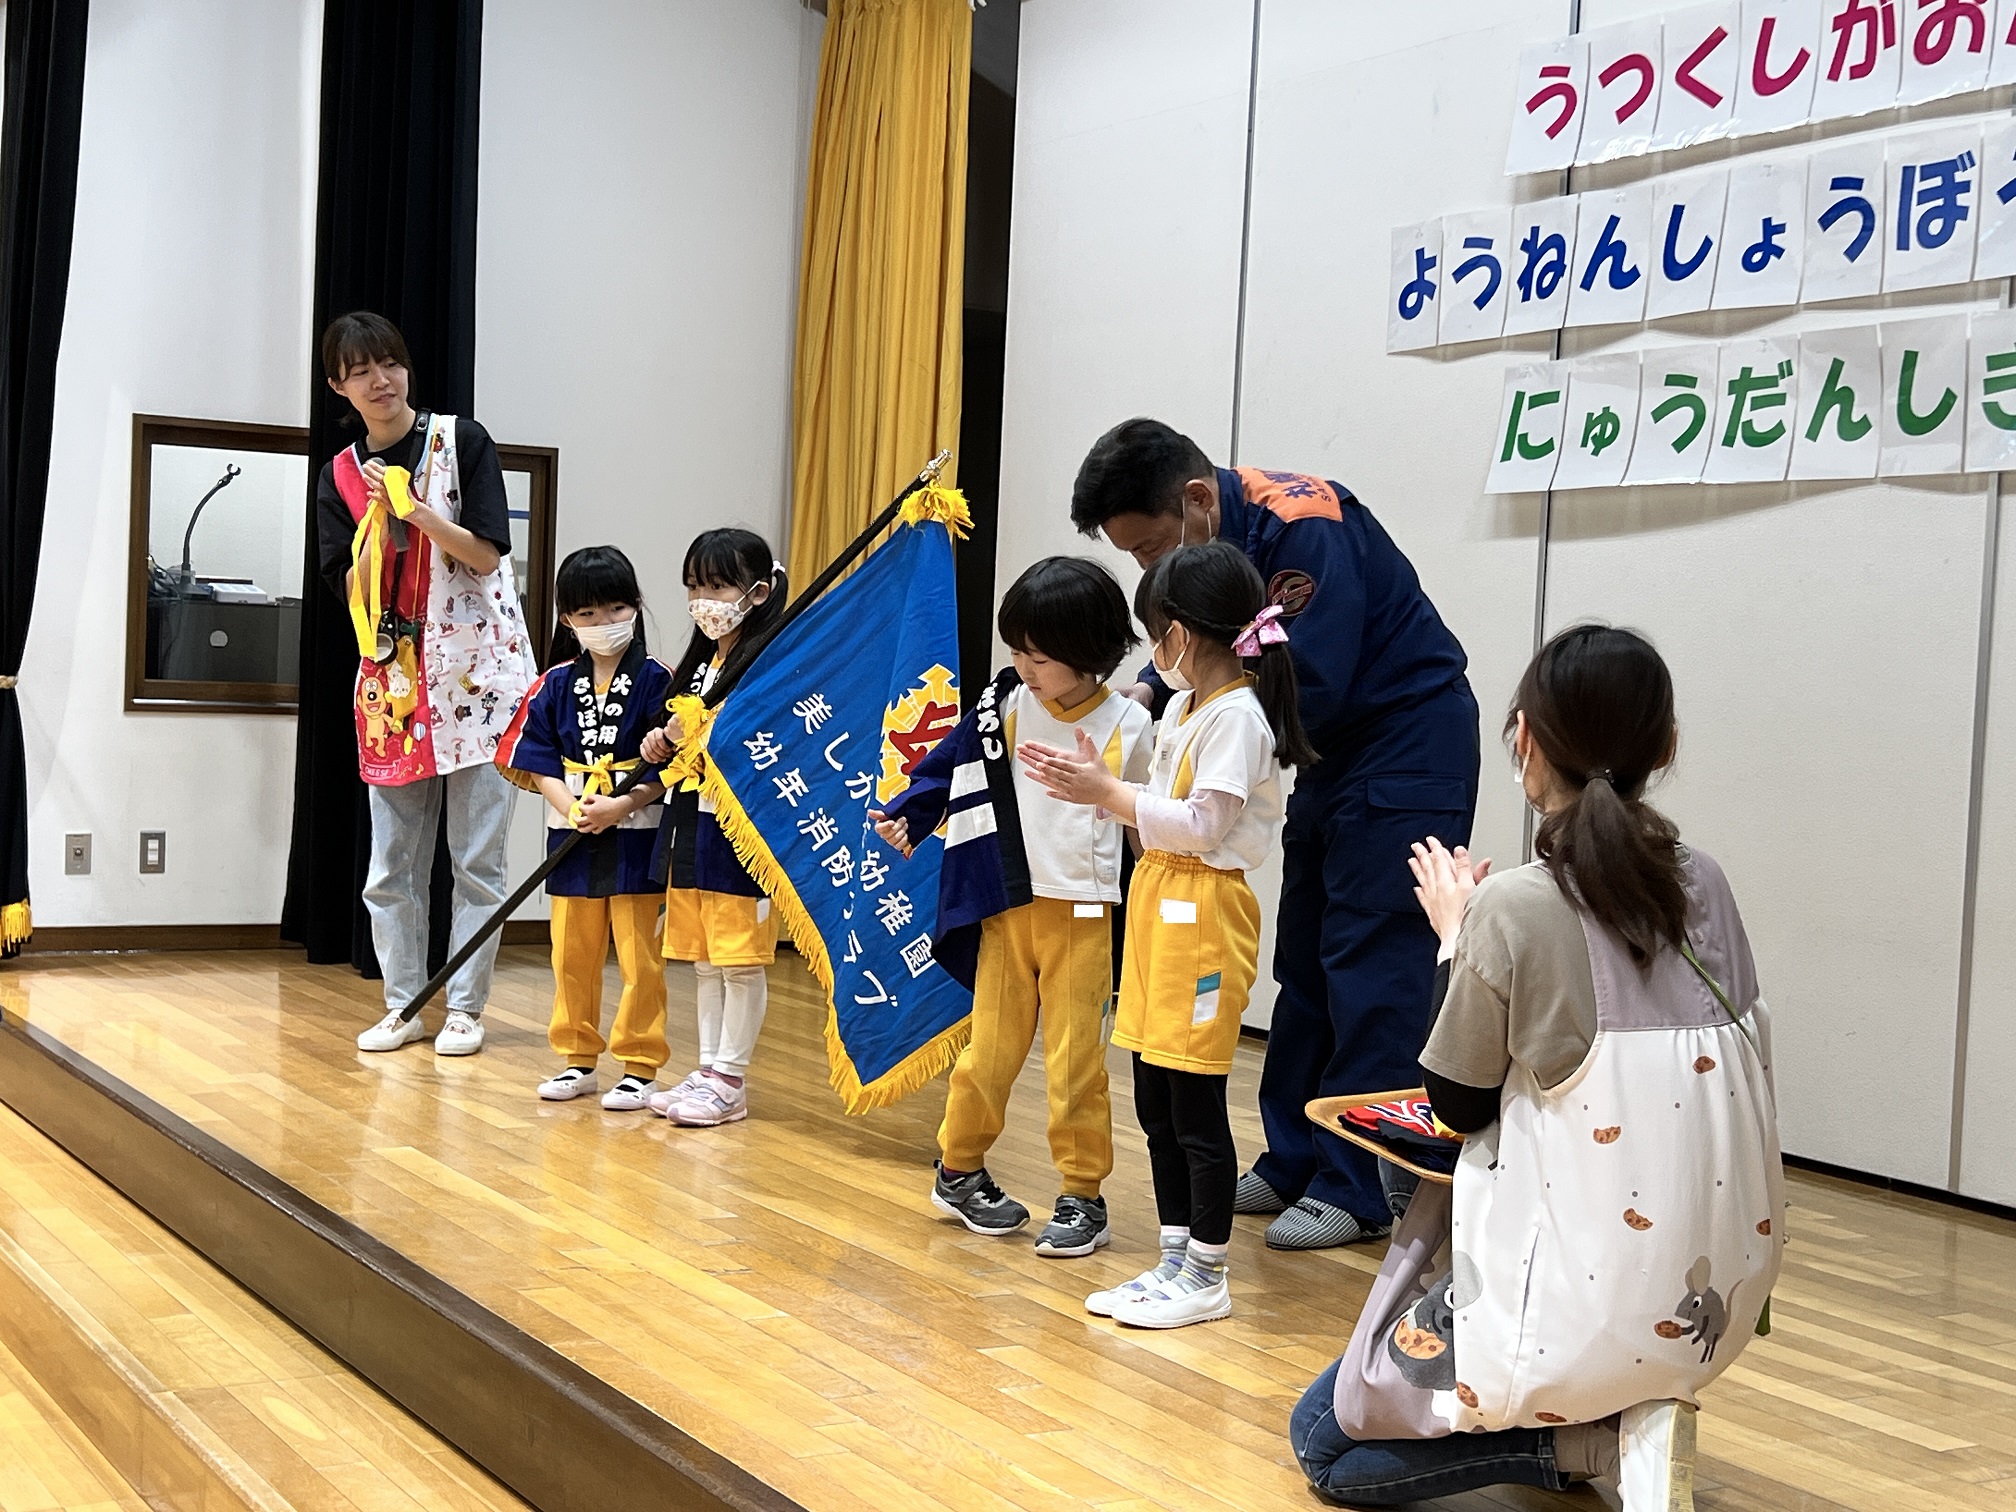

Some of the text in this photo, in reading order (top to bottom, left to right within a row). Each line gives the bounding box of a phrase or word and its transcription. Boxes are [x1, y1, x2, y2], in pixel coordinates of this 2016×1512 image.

[1525, 0, 2016, 140] うつくしがお
[598, 673, 632, 758] 火の用
